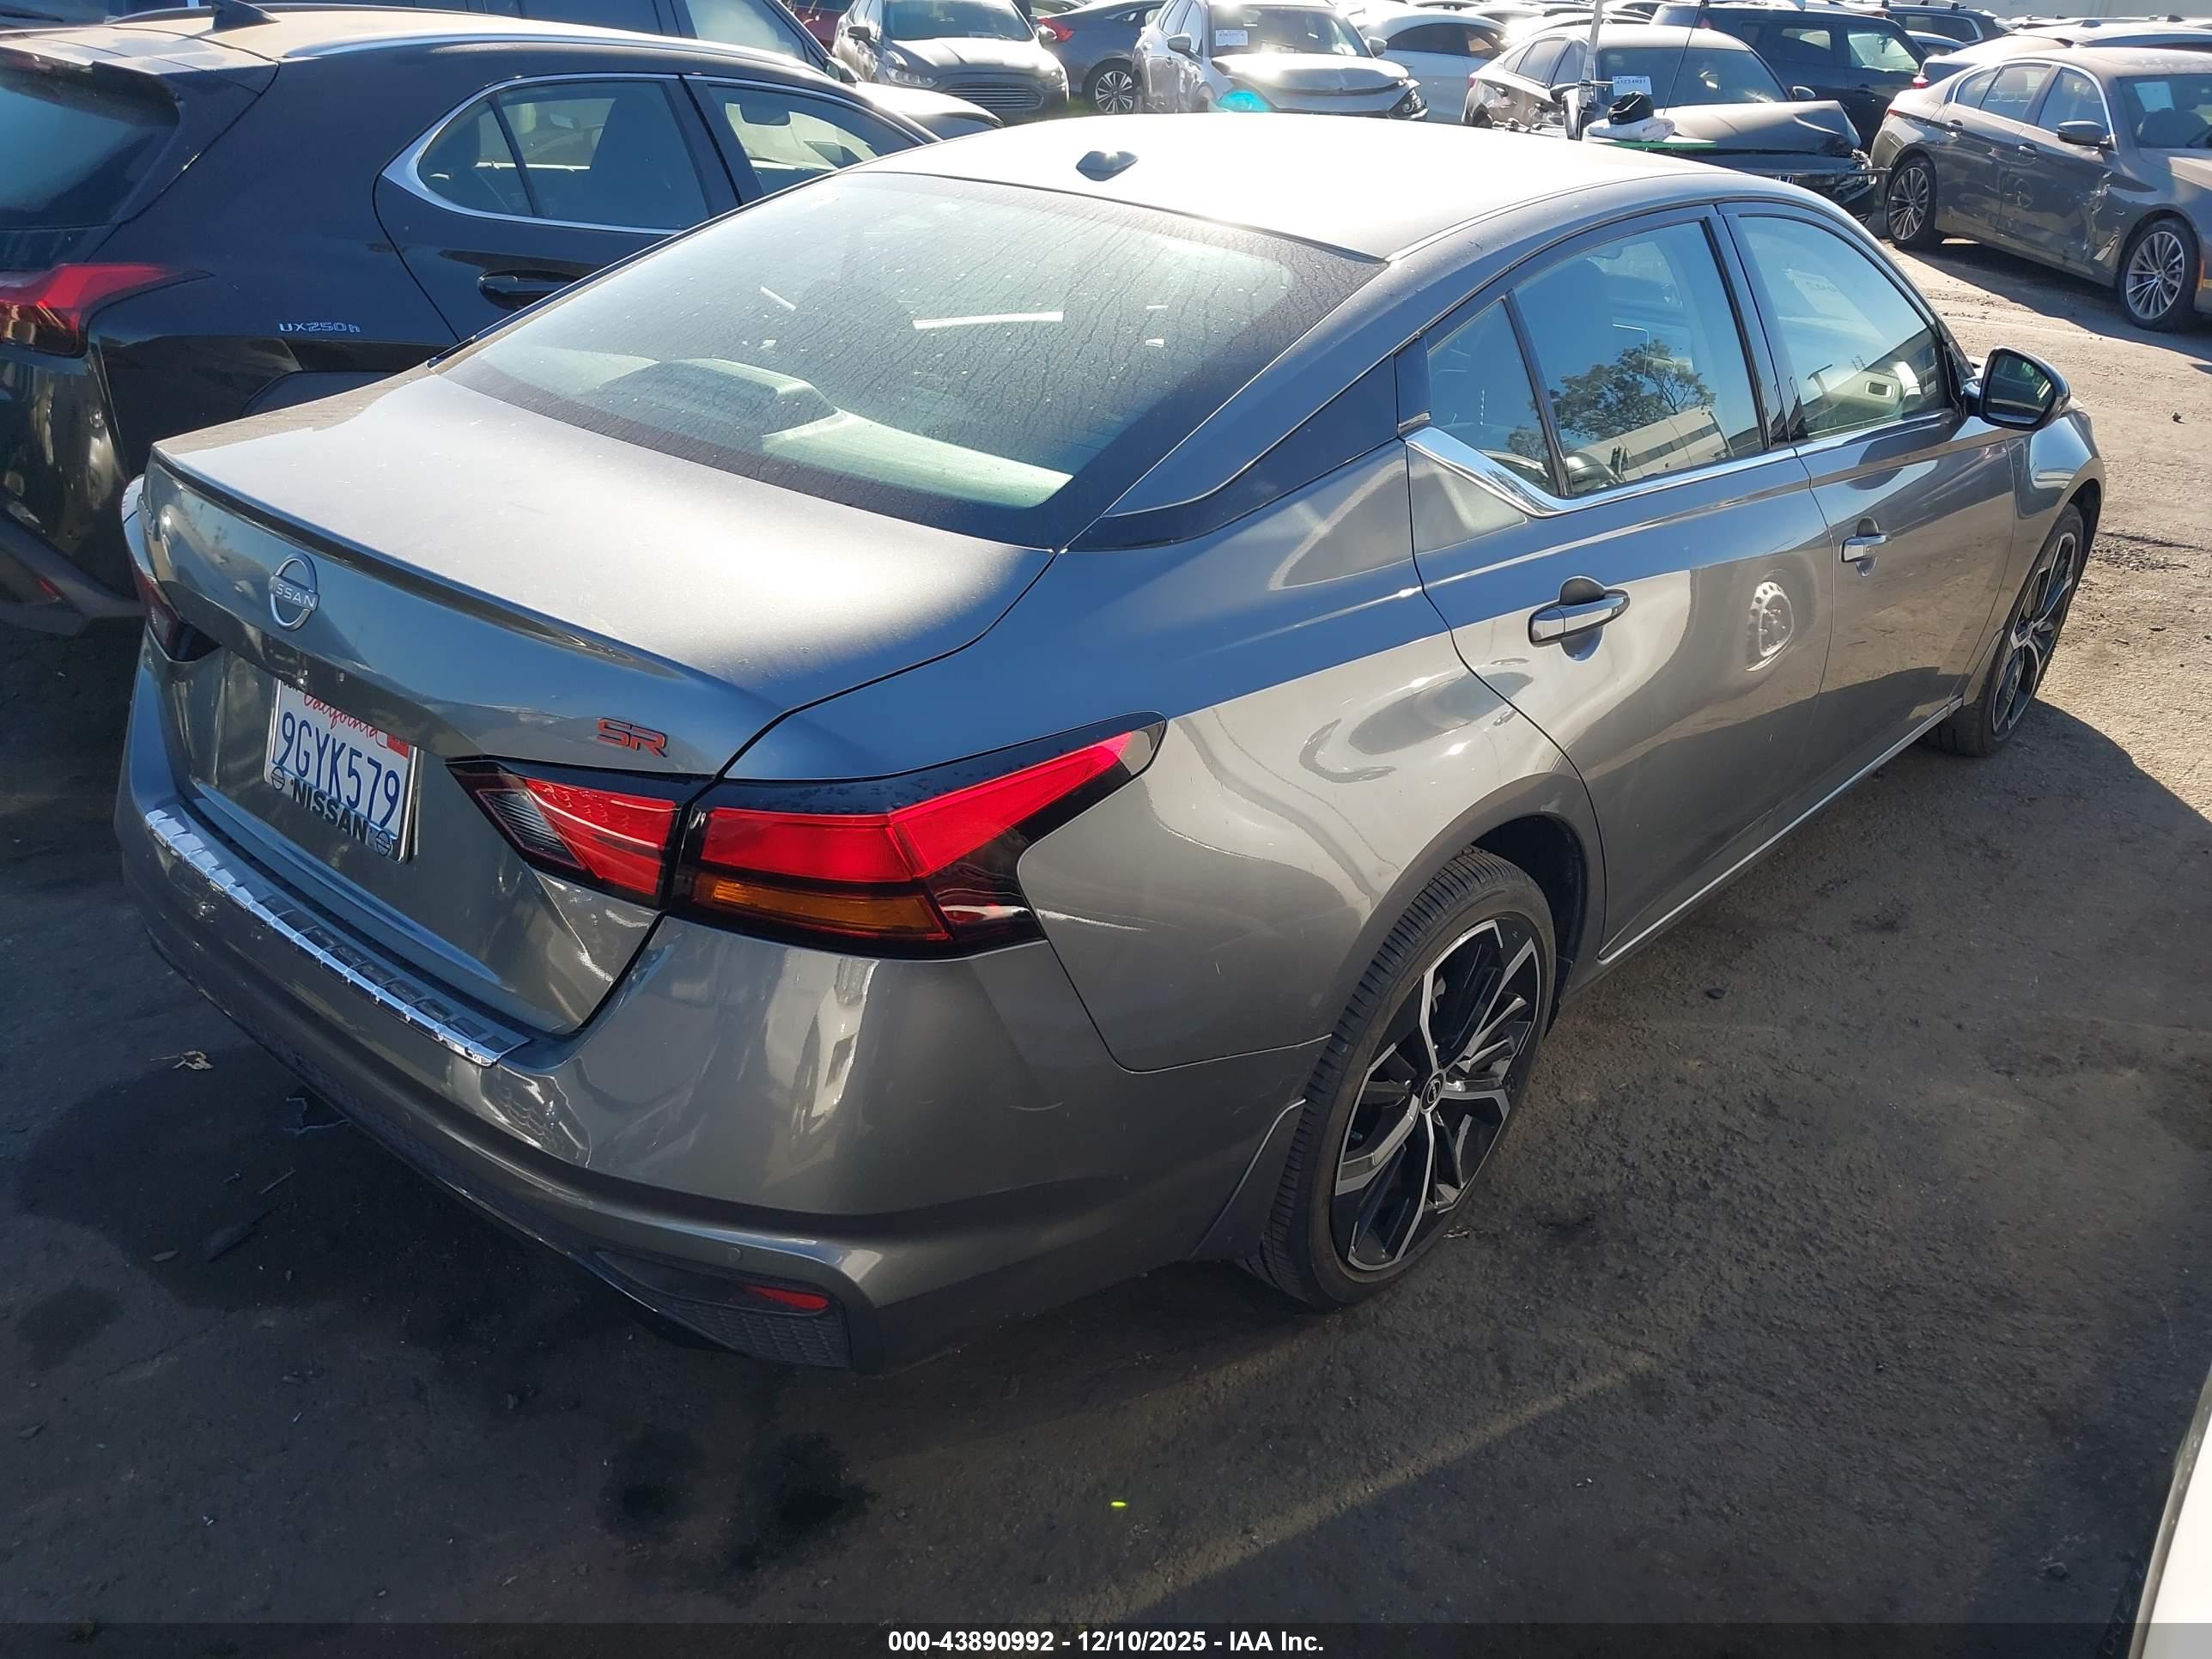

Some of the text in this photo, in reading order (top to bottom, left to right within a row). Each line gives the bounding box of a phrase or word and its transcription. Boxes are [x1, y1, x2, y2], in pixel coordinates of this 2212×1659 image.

[279, 321, 361, 333] UX250h
[273, 582, 316, 608] SSAN
[597, 716, 668, 757] SR
[277, 711, 401, 828] 9GYK579
[292, 779, 368, 844] NISSAN
